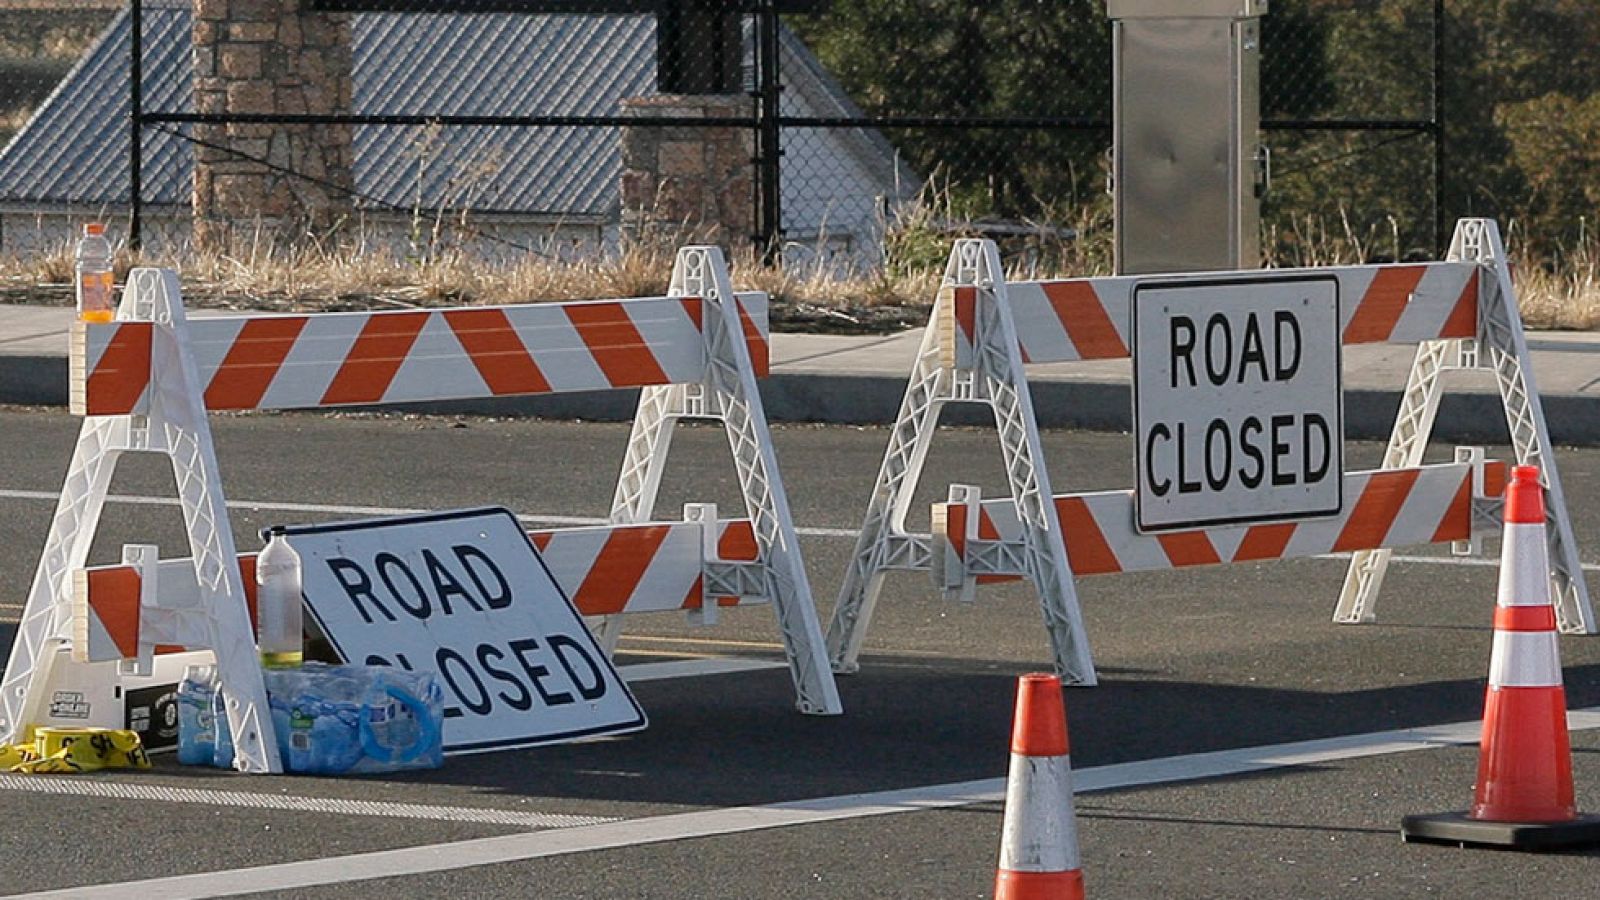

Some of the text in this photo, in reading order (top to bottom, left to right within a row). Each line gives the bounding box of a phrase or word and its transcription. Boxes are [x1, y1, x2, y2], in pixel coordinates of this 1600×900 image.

[1170, 309, 1302, 388] ROAD
[1145, 412, 1331, 497] CLOSED
[325, 544, 512, 624] ROAD
[364, 634, 607, 718] OSED
